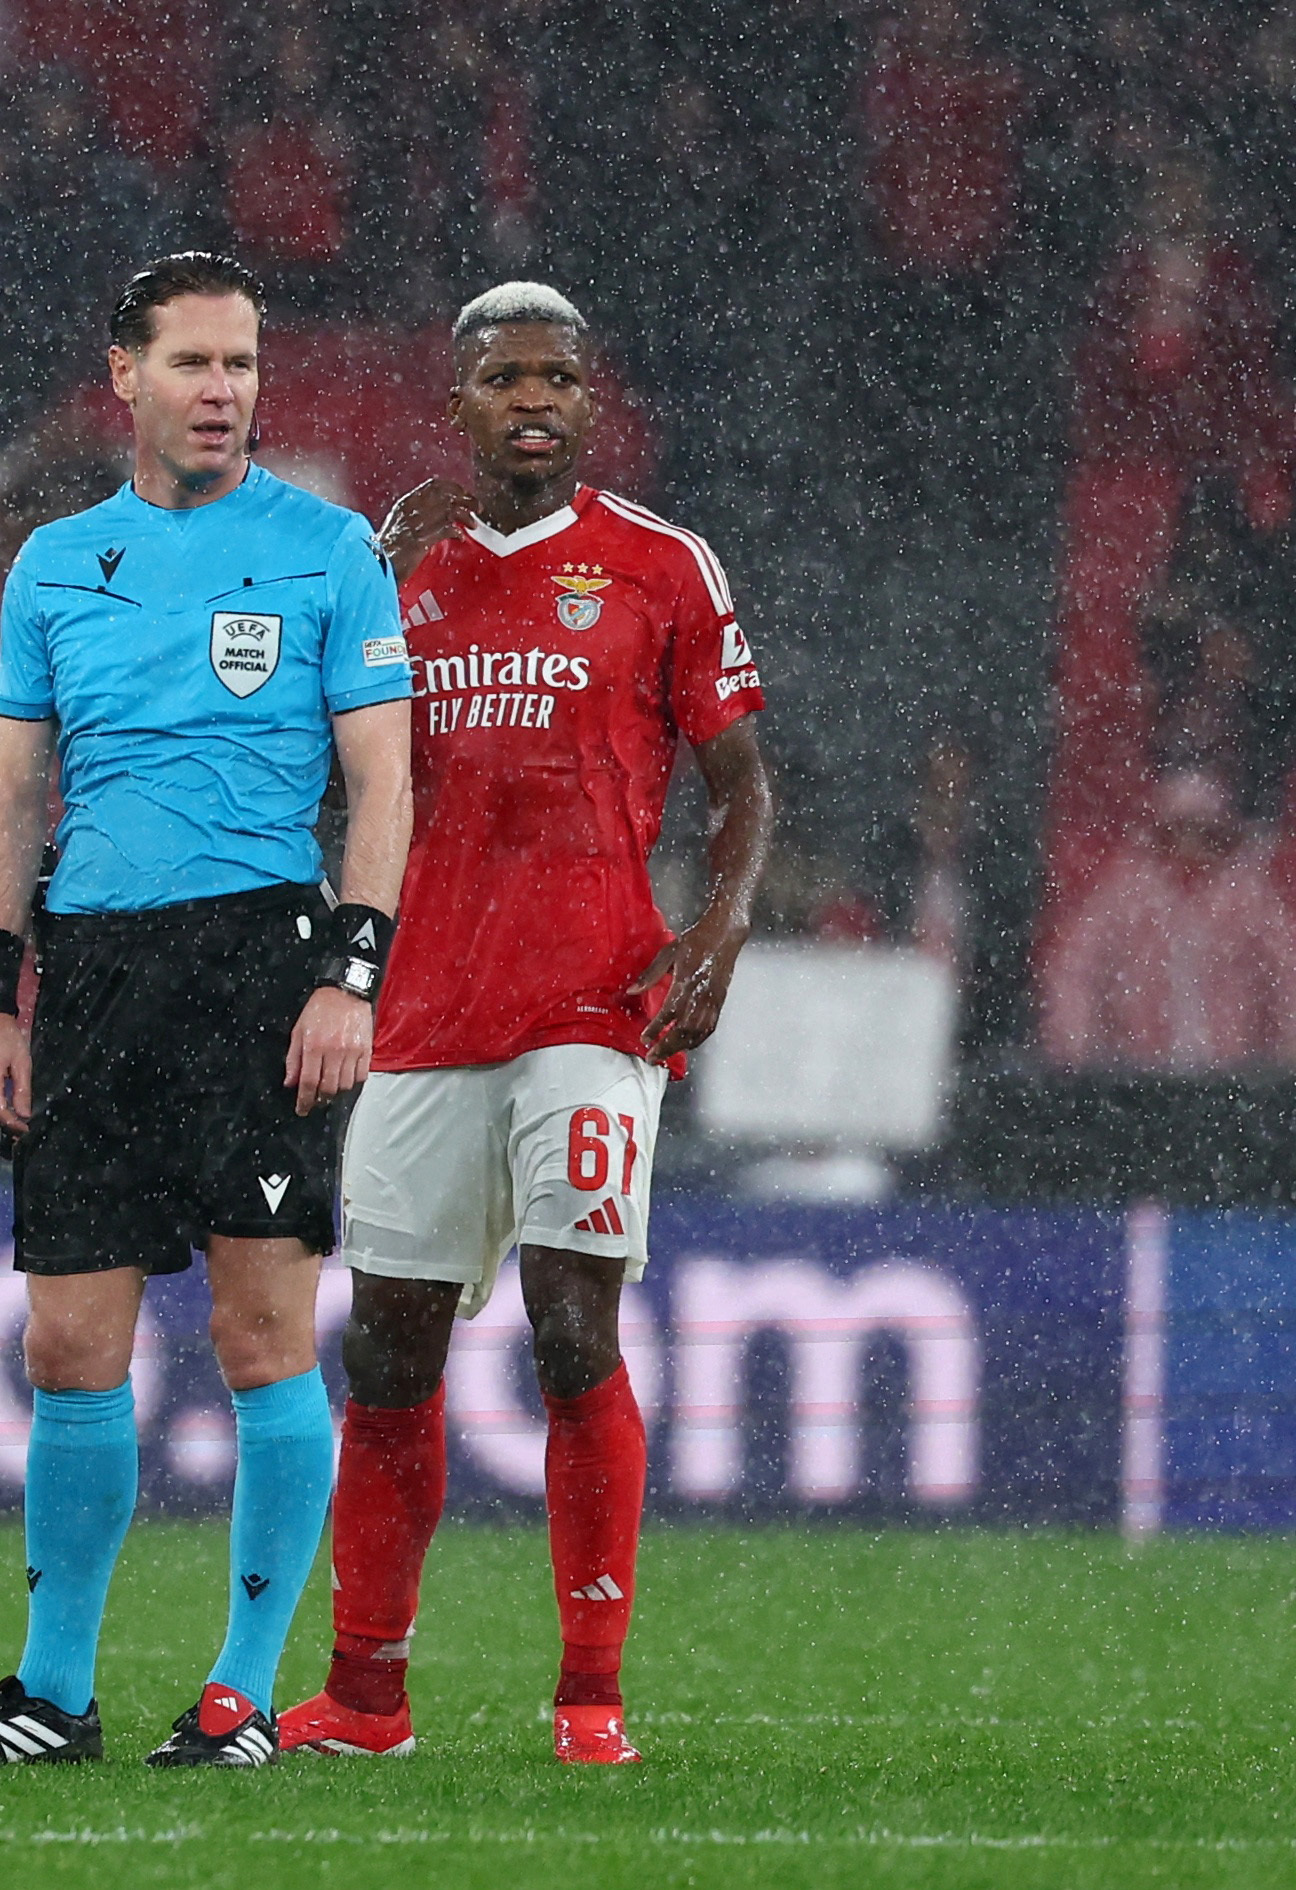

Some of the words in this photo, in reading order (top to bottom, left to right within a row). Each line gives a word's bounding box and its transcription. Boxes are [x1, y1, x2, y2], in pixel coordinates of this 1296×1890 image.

[225, 622, 266, 640] UEFA
[225, 648, 265, 659] MATCH
[366, 645, 406, 658] FOUND
[219, 660, 268, 672] OFFICIAL
[429, 698, 463, 736] FLY
[466, 693, 554, 729] BETTER
[567, 1107, 637, 1195] 61
